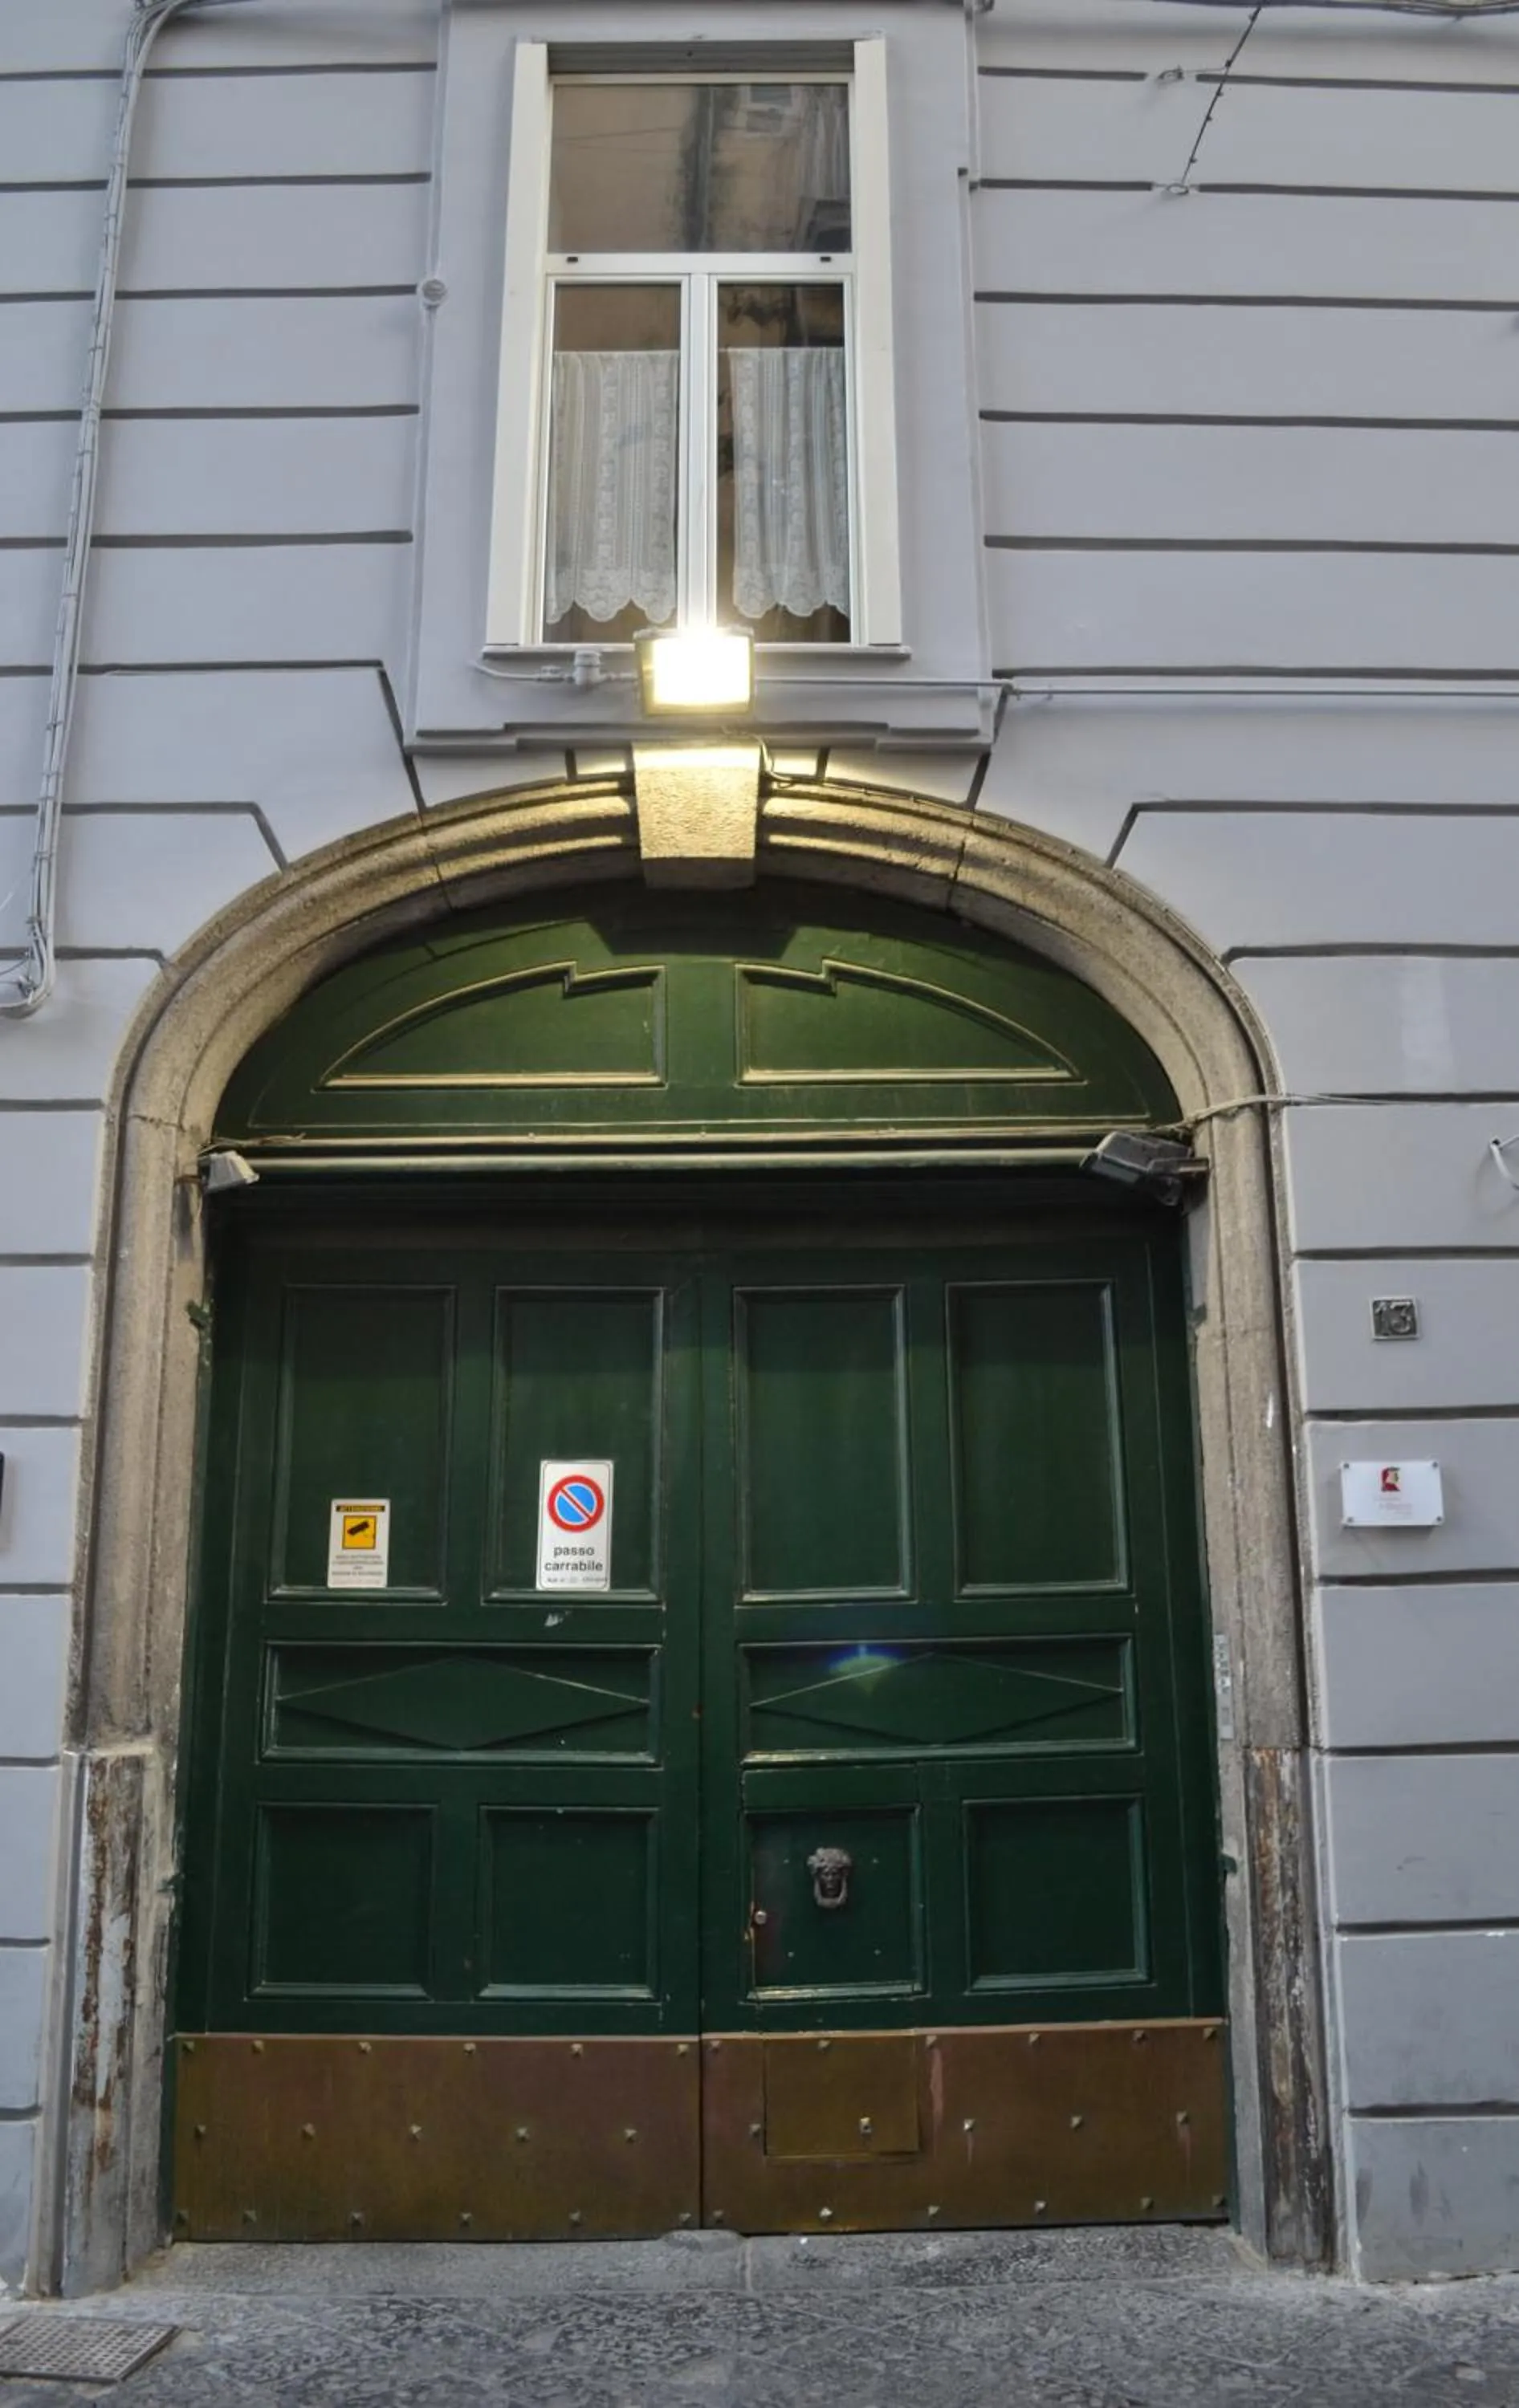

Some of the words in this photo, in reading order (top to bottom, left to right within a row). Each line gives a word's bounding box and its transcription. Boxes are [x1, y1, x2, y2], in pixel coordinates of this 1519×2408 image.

[1374, 1301, 1411, 1335] 13
[553, 1547, 596, 1558] passo
[544, 1560, 604, 1572] carrabile
